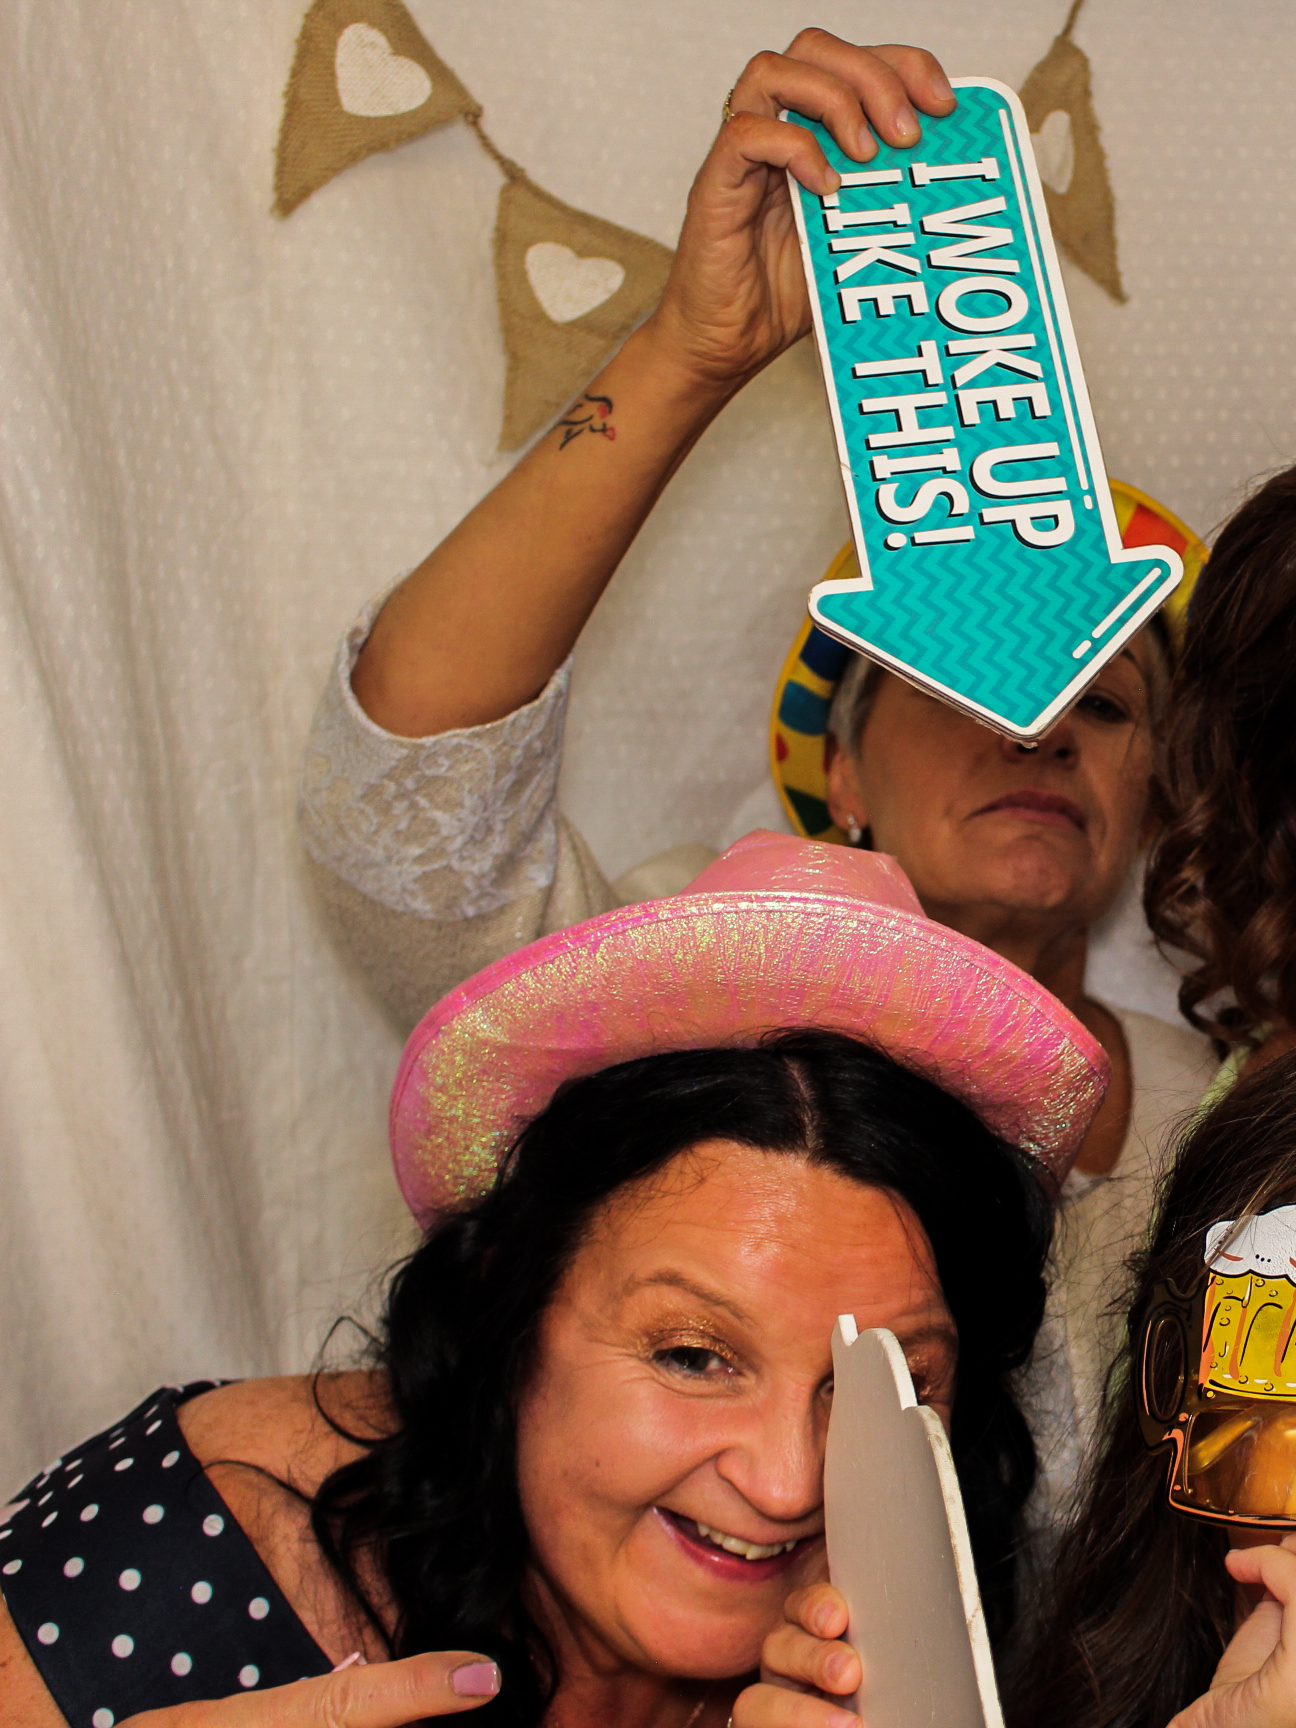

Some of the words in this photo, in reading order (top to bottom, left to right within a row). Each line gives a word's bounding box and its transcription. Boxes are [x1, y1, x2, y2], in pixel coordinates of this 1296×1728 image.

[821, 168, 931, 325] LIKE
[908, 156, 1001, 187] I
[920, 196, 1052, 427] WOKE
[851, 339, 977, 550] THIS!
[969, 441, 1076, 549] UP
